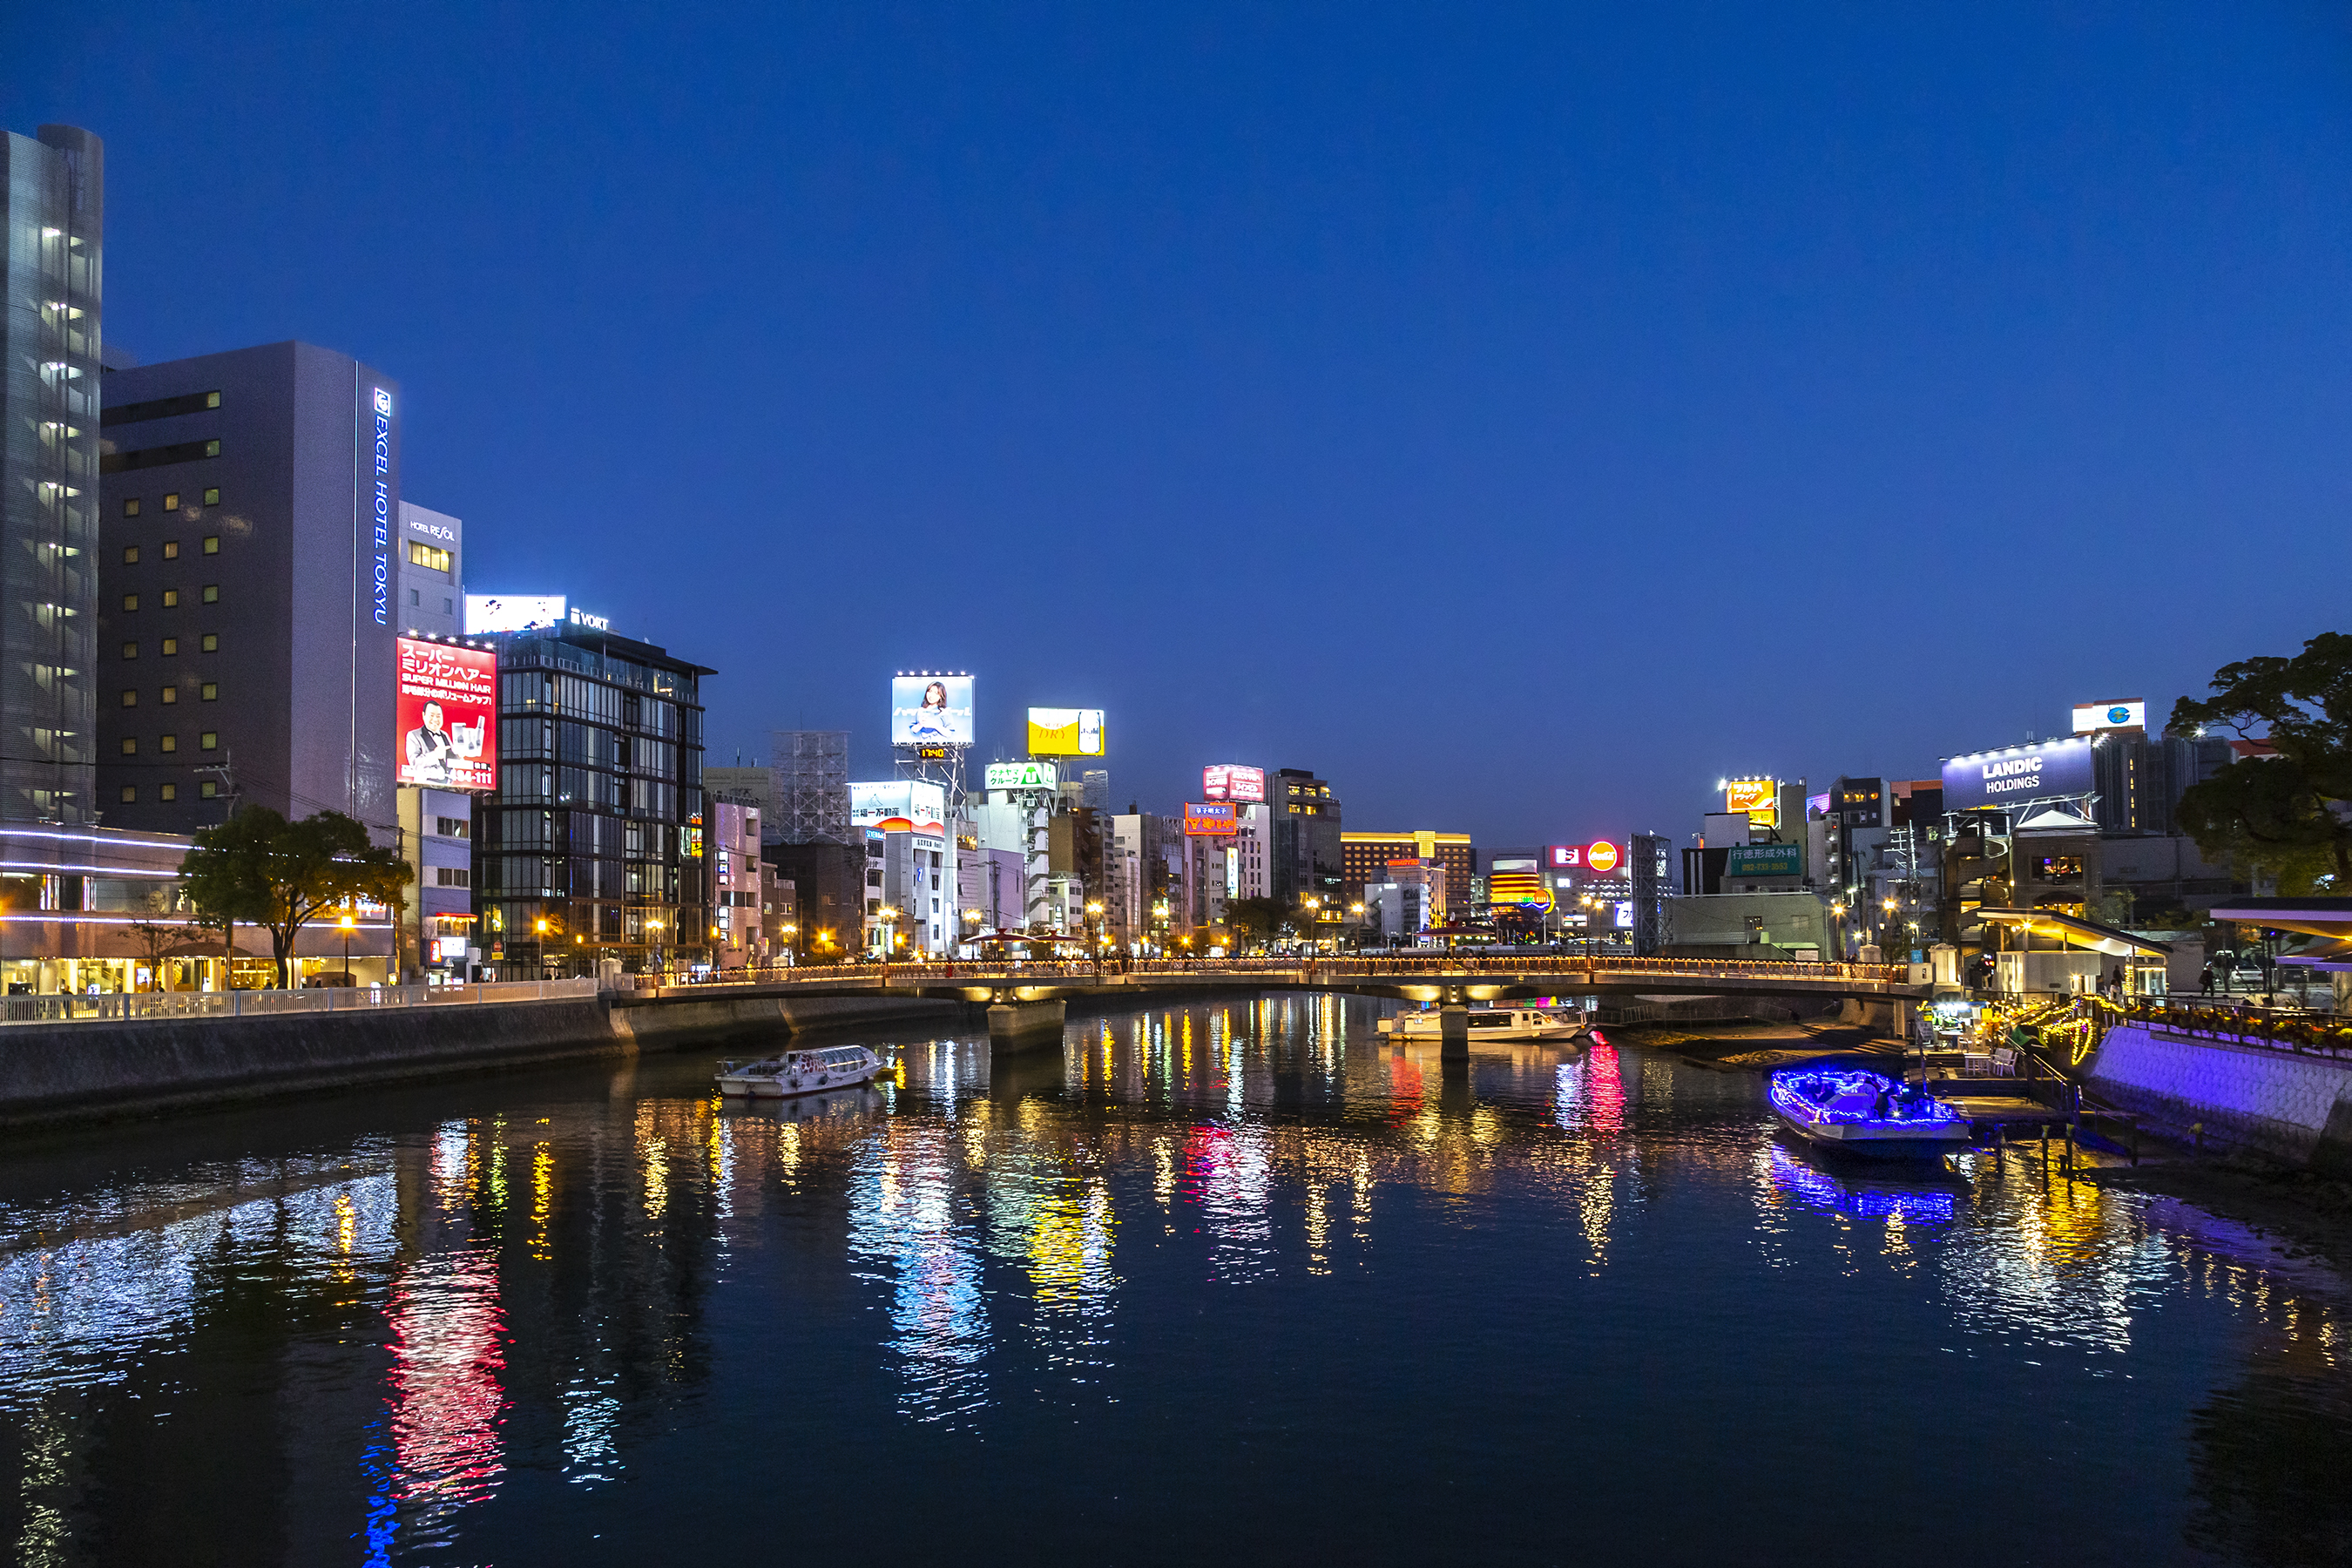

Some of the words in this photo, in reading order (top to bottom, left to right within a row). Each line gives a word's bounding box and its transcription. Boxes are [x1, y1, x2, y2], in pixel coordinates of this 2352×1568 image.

[375, 415, 389, 477] EXCEL
[375, 480, 389, 550] HOTEL
[410, 520, 429, 534] HOTEL
[429, 524, 455, 542] RESOL
[374, 552, 388, 626] TOKYU
[580, 612, 609, 631] VORT
[402, 644, 456, 664] スーパー
[402, 658, 492, 681] ミリオンヘアー
[402, 672, 434, 686] SUPER
[435, 677, 470, 691] MILLION
[470, 683, 492, 694] HAIR
[1038, 729, 1065, 740] DRY
[922, 749, 944, 758] 17:40
[990, 768, 1019, 777] ウチヤマ
[1983, 756, 2043, 779] LANDIC
[1986, 775, 2040, 794] HOLDINGS
[1733, 848, 1797, 860] 行徳形成外科
